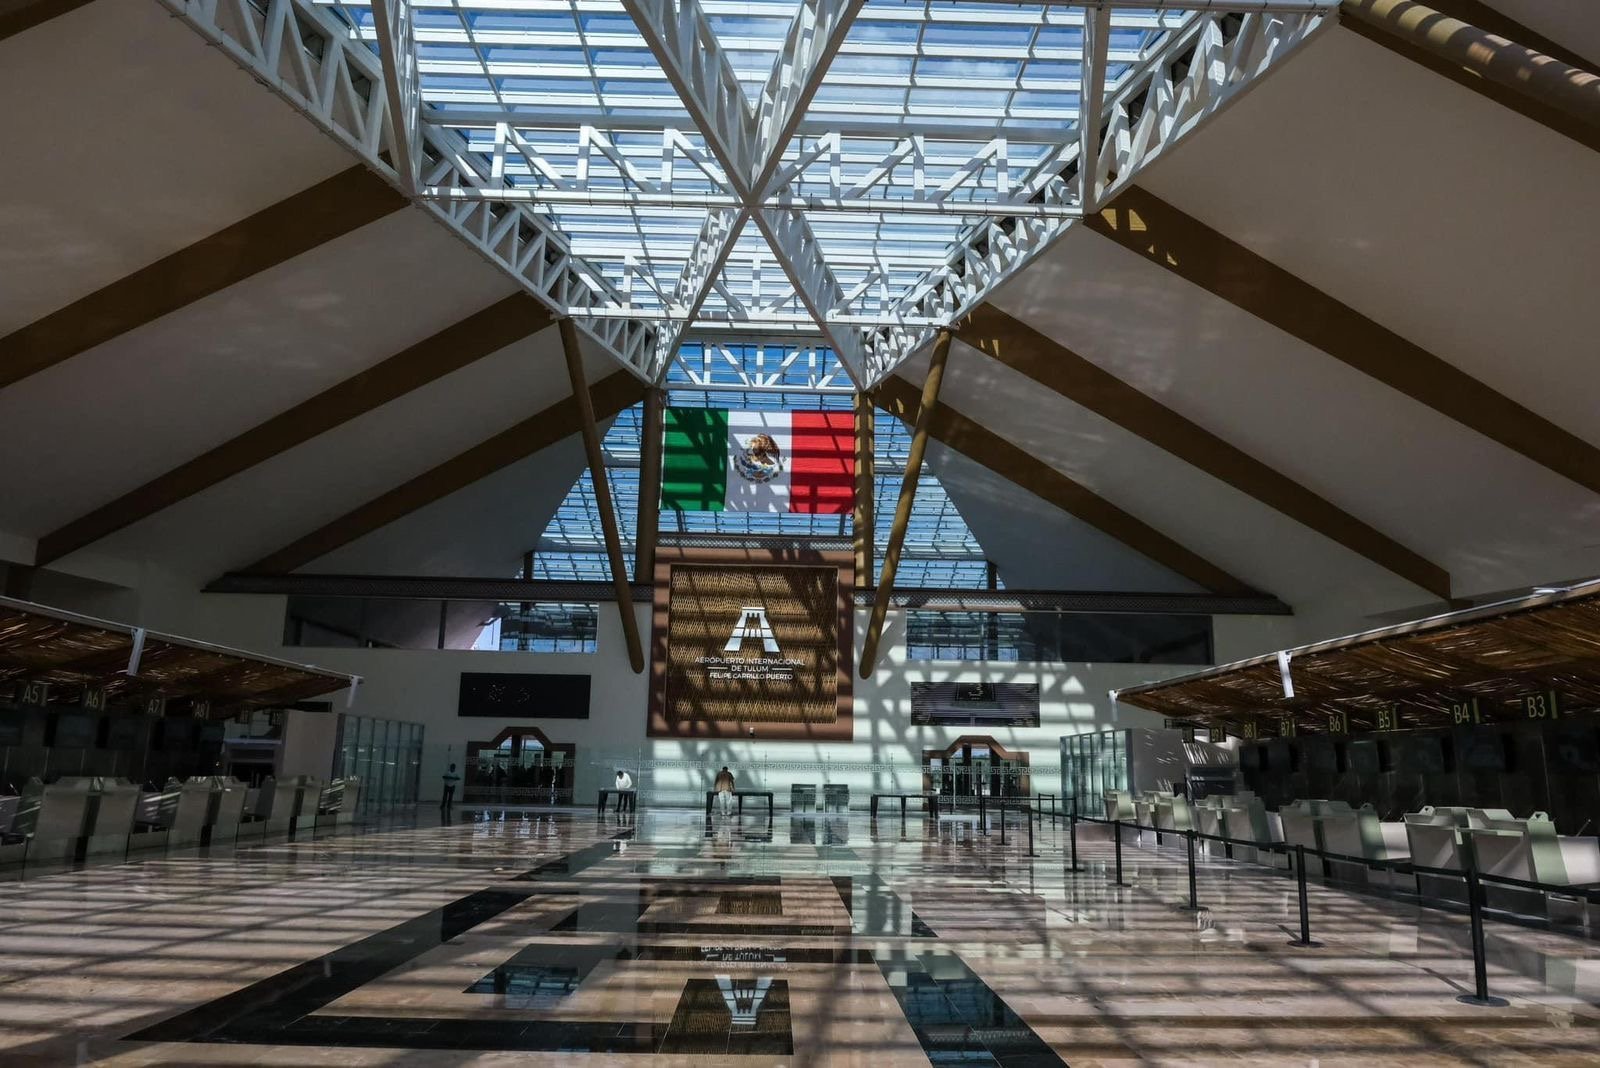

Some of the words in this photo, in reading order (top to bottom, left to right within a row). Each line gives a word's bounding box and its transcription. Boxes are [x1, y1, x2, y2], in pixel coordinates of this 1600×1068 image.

[694, 656, 745, 664] AEROPUERTO
[746, 657, 805, 666] INTERNACIONAL
[22, 685, 39, 704] A5
[85, 690, 98, 707] A6
[148, 698, 160, 714] A7
[1454, 703, 1470, 724] B4
[1527, 695, 1546, 718] B3
[1329, 716, 1341, 732] B6
[1378, 711, 1390, 728] B5
[1281, 721, 1290, 736] B7
